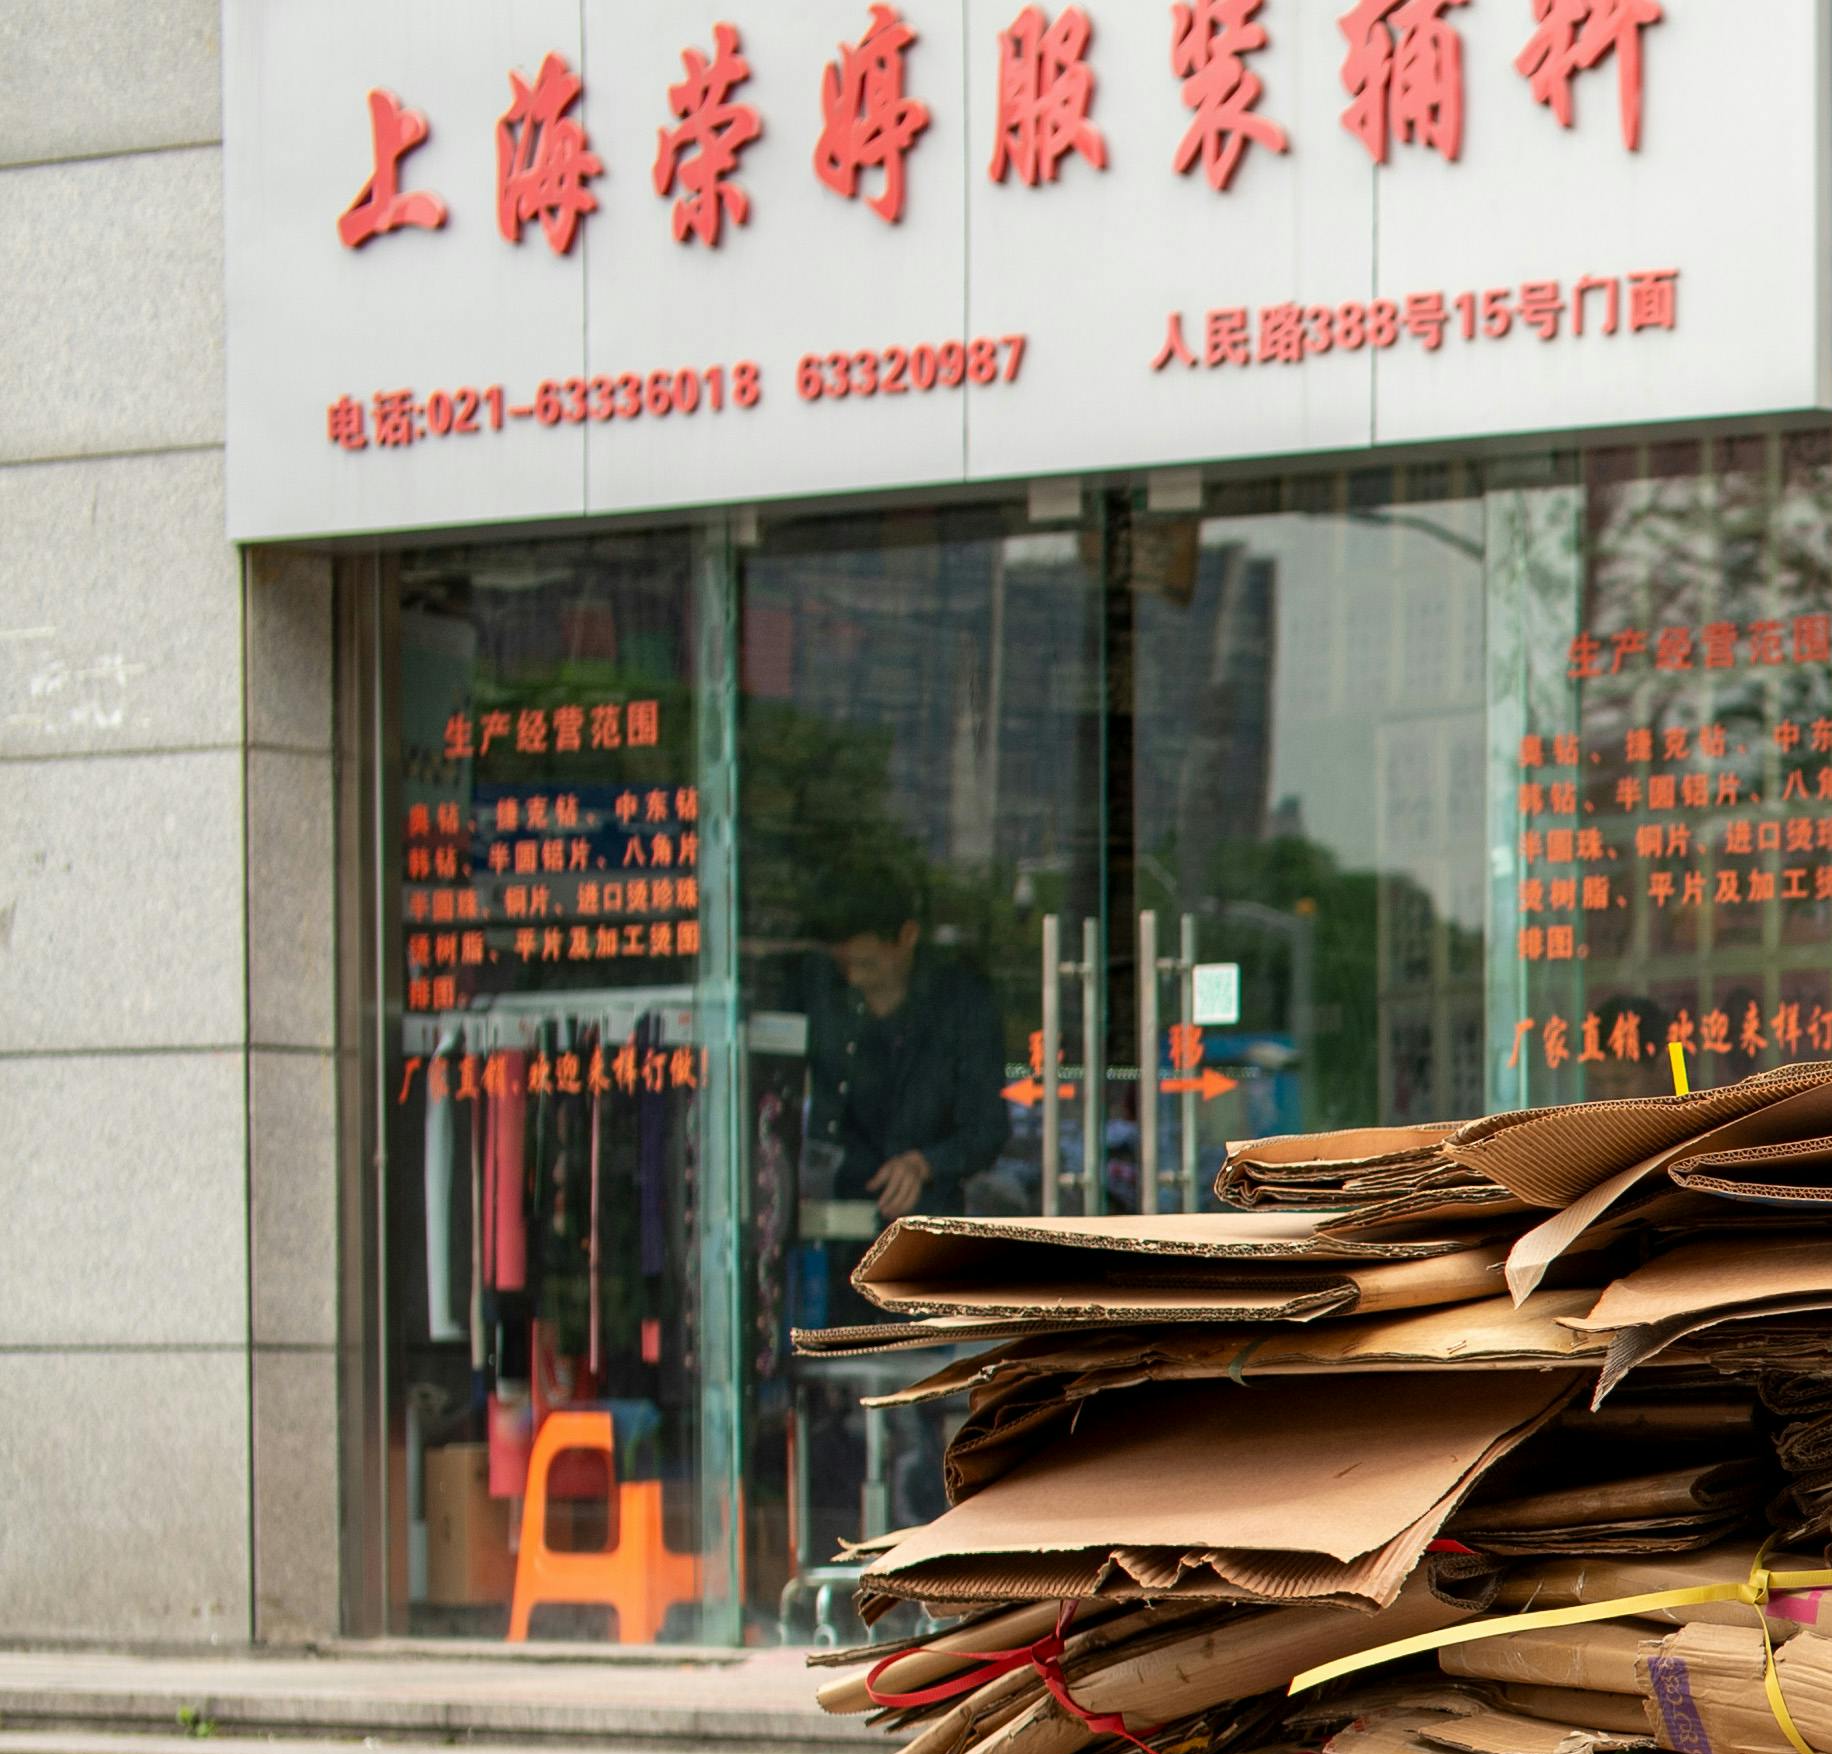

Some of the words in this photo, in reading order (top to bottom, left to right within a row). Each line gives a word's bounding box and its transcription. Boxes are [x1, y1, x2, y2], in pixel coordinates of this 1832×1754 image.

[336, 0, 1664, 256] 上海荣婷服装辅料
[1151, 269, 1678, 369] 人民路388号15号门面
[327, 360, 762, 450] 电话:021-63336018
[795, 334, 1027, 401] 63320987
[1567, 614, 1831, 678] 生产经营范围
[444, 700, 659, 758] 生产经营范围
